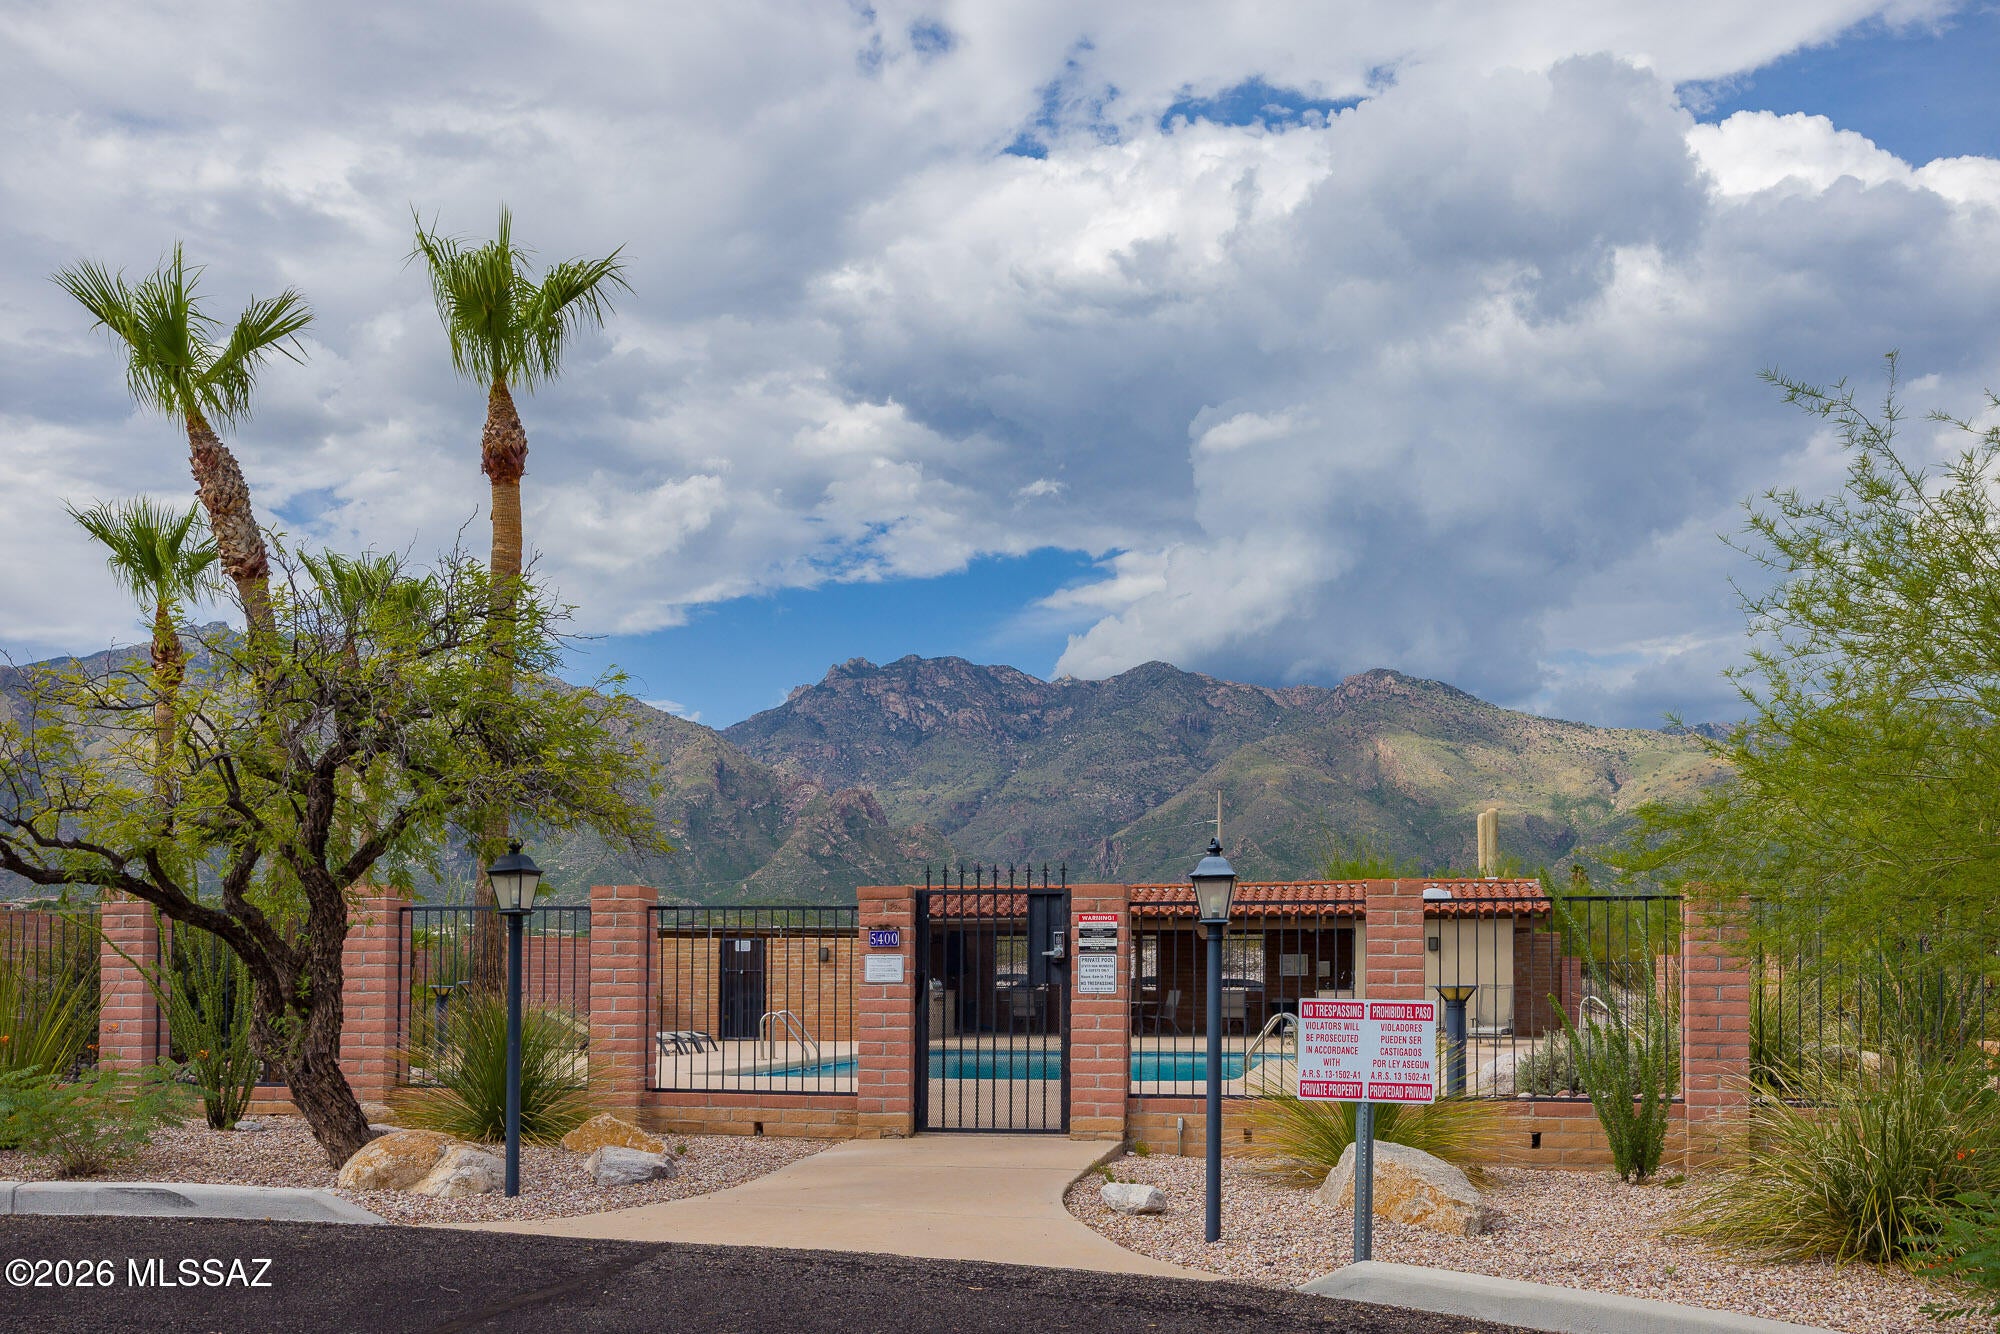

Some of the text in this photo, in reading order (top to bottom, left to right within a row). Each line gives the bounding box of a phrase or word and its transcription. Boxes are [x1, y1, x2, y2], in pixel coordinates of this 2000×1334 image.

[871, 933, 897, 944] 5400
[1304, 1004, 1362, 1018] NO TRESPASSING
[1373, 1006, 1431, 1019] PROHIBIDO EL PASO
[1306, 1022, 1359, 1031] VIOLATORS WILL
[1381, 1024, 1422, 1032] VIOLADORES
[1316, 1034, 1358, 1043] PROSECUTED
[1381, 1036, 1422, 1044] PUEDEN SER
[1315, 1046, 1358, 1055] ACCORDANCE
[1380, 1048, 1422, 1056] CASTIGADOS
[1323, 1058, 1340, 1066] WITH
[1373, 1060, 1429, 1069] POR LEY ASEGUN
[1302, 1070, 1360, 1079] A.R.S. 13-1502-A1
[1371, 1072, 1430, 1081] A.R.S. 13 1502-A1
[1302, 1084, 1361, 1097] PRIVATE PROPERTY
[1370, 1084, 1431, 1099] PROPIEDAD PRIVADA
